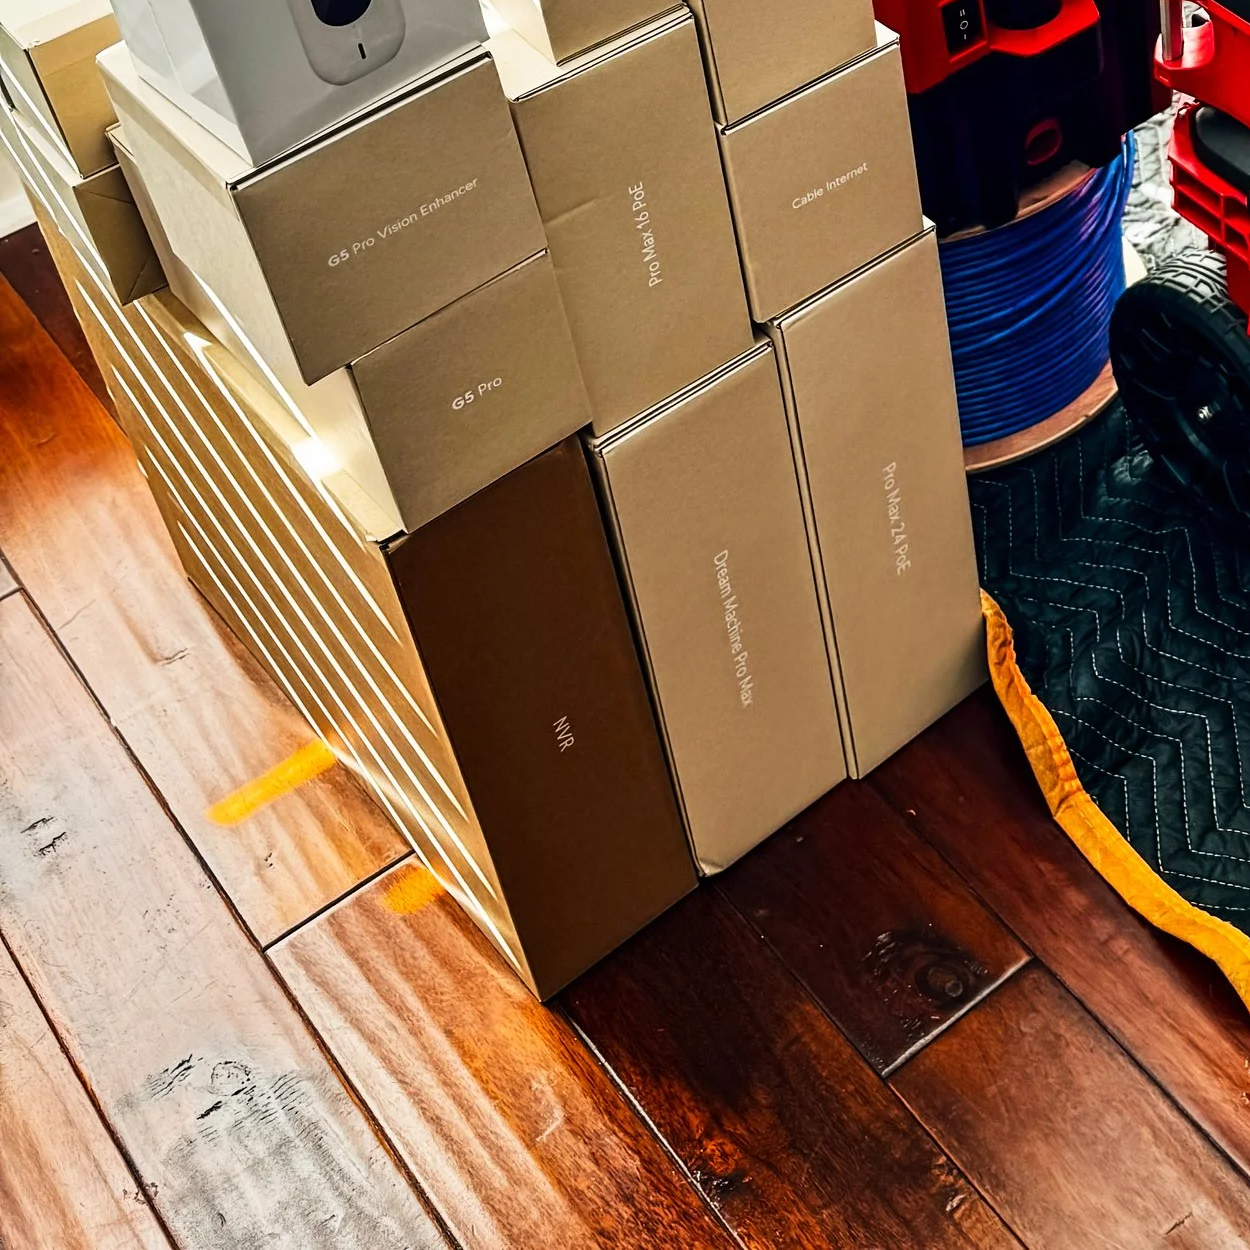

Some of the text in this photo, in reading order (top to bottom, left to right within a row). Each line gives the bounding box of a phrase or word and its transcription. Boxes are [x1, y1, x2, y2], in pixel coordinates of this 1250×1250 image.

[327, 178, 478, 267] G5 Pro Vision Enhancer
[792, 162, 868, 209] Cable Internet
[628, 181, 663, 287] Pro Max 16 PoE
[452, 377, 502, 410] G5 Pro
[883, 462, 912, 576] Pro Max 24 PoE
[714, 549, 754, 708] Dream Machine Pro Max
[552, 715, 575, 753] NVR
